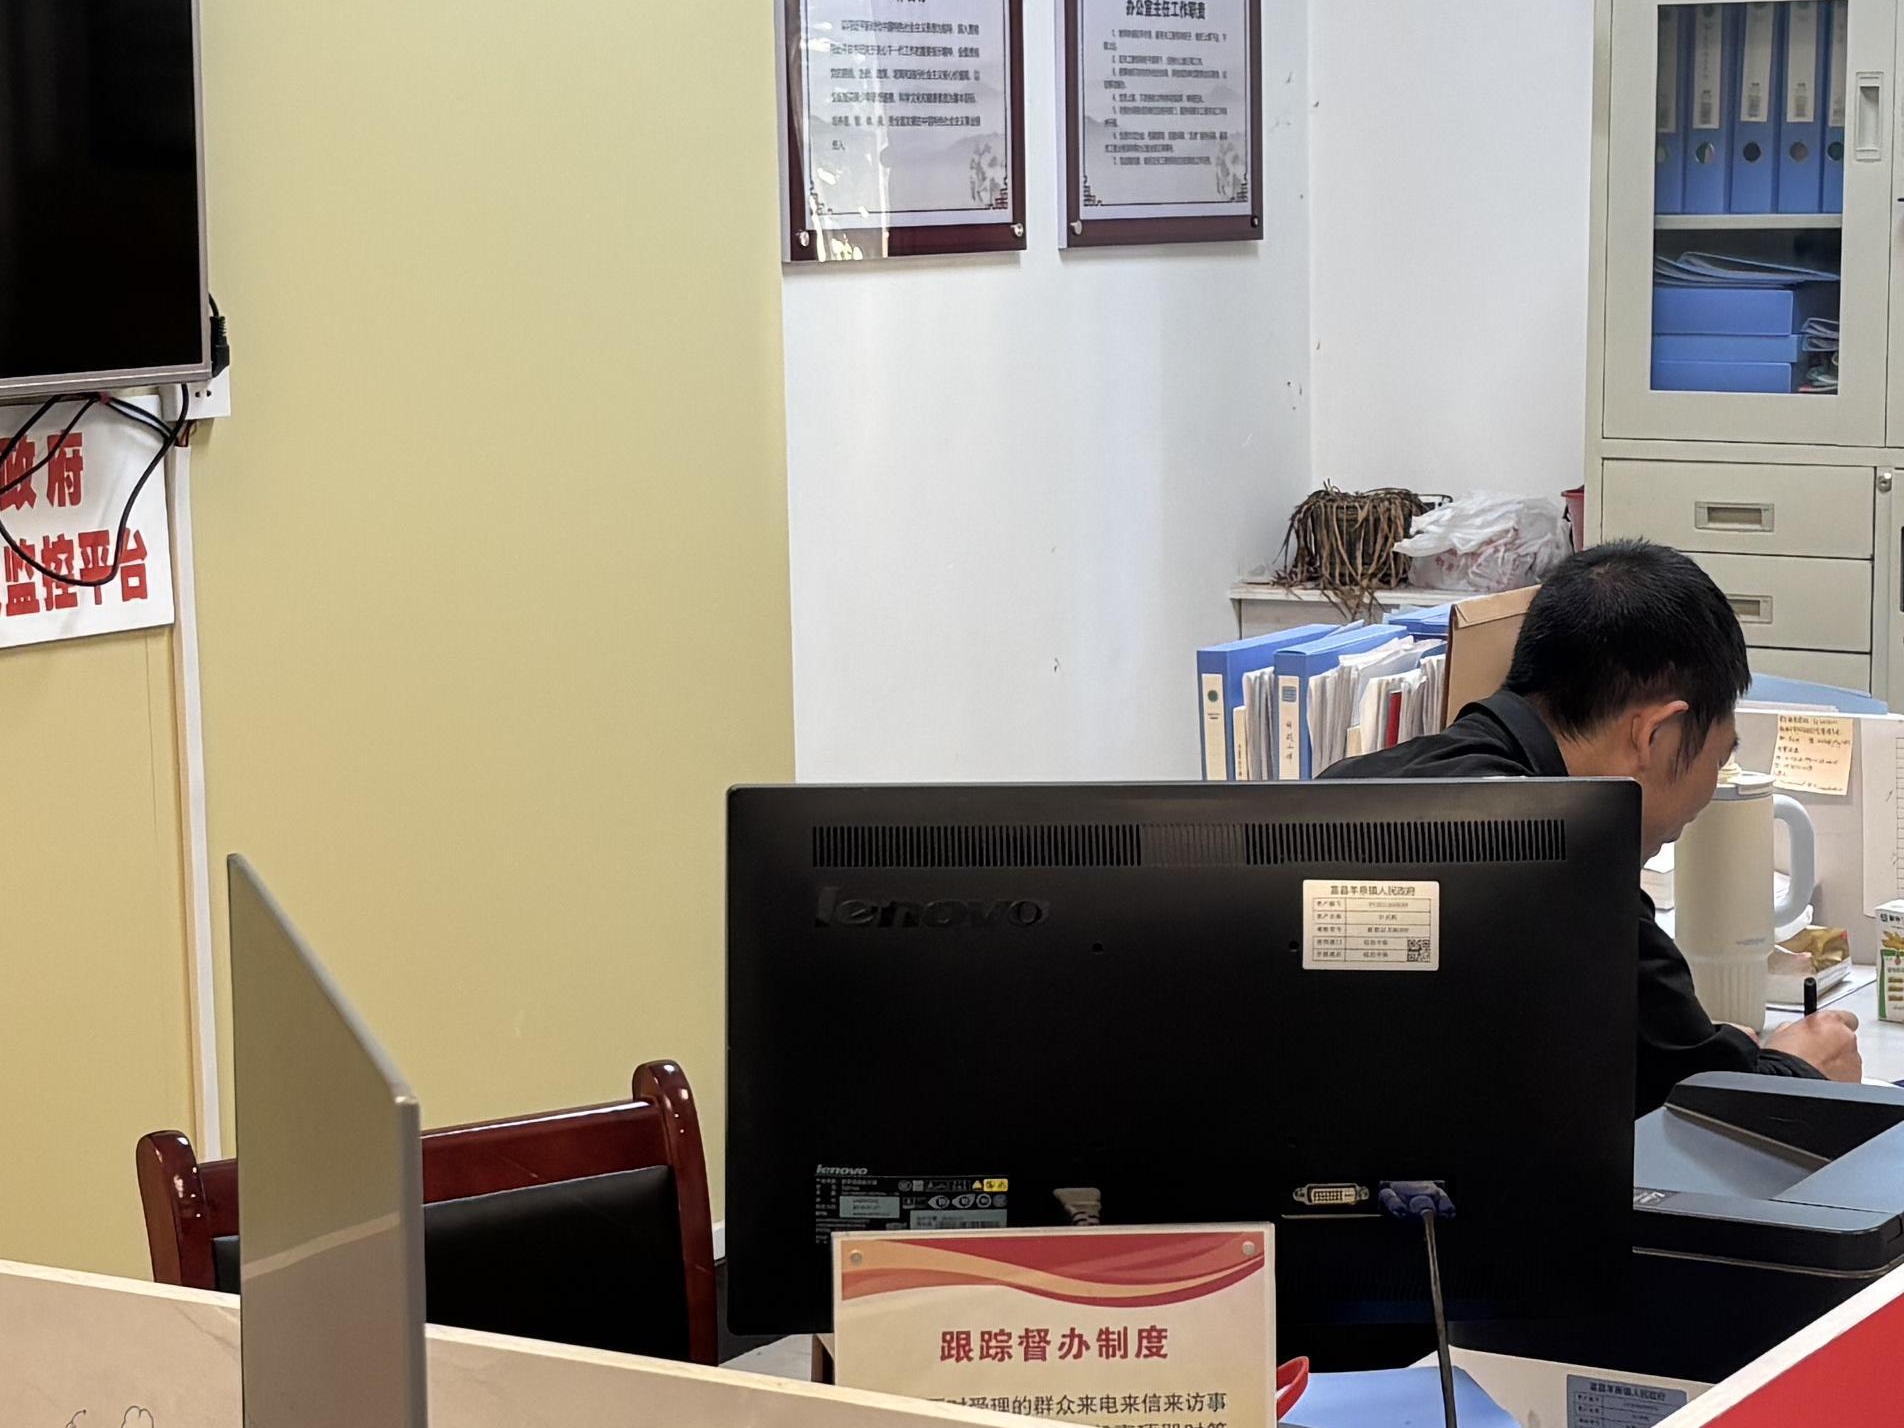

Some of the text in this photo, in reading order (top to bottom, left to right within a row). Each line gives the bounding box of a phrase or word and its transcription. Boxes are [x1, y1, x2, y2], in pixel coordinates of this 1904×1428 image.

[939, 1324, 1170, 1364] 跟踪督办制度
